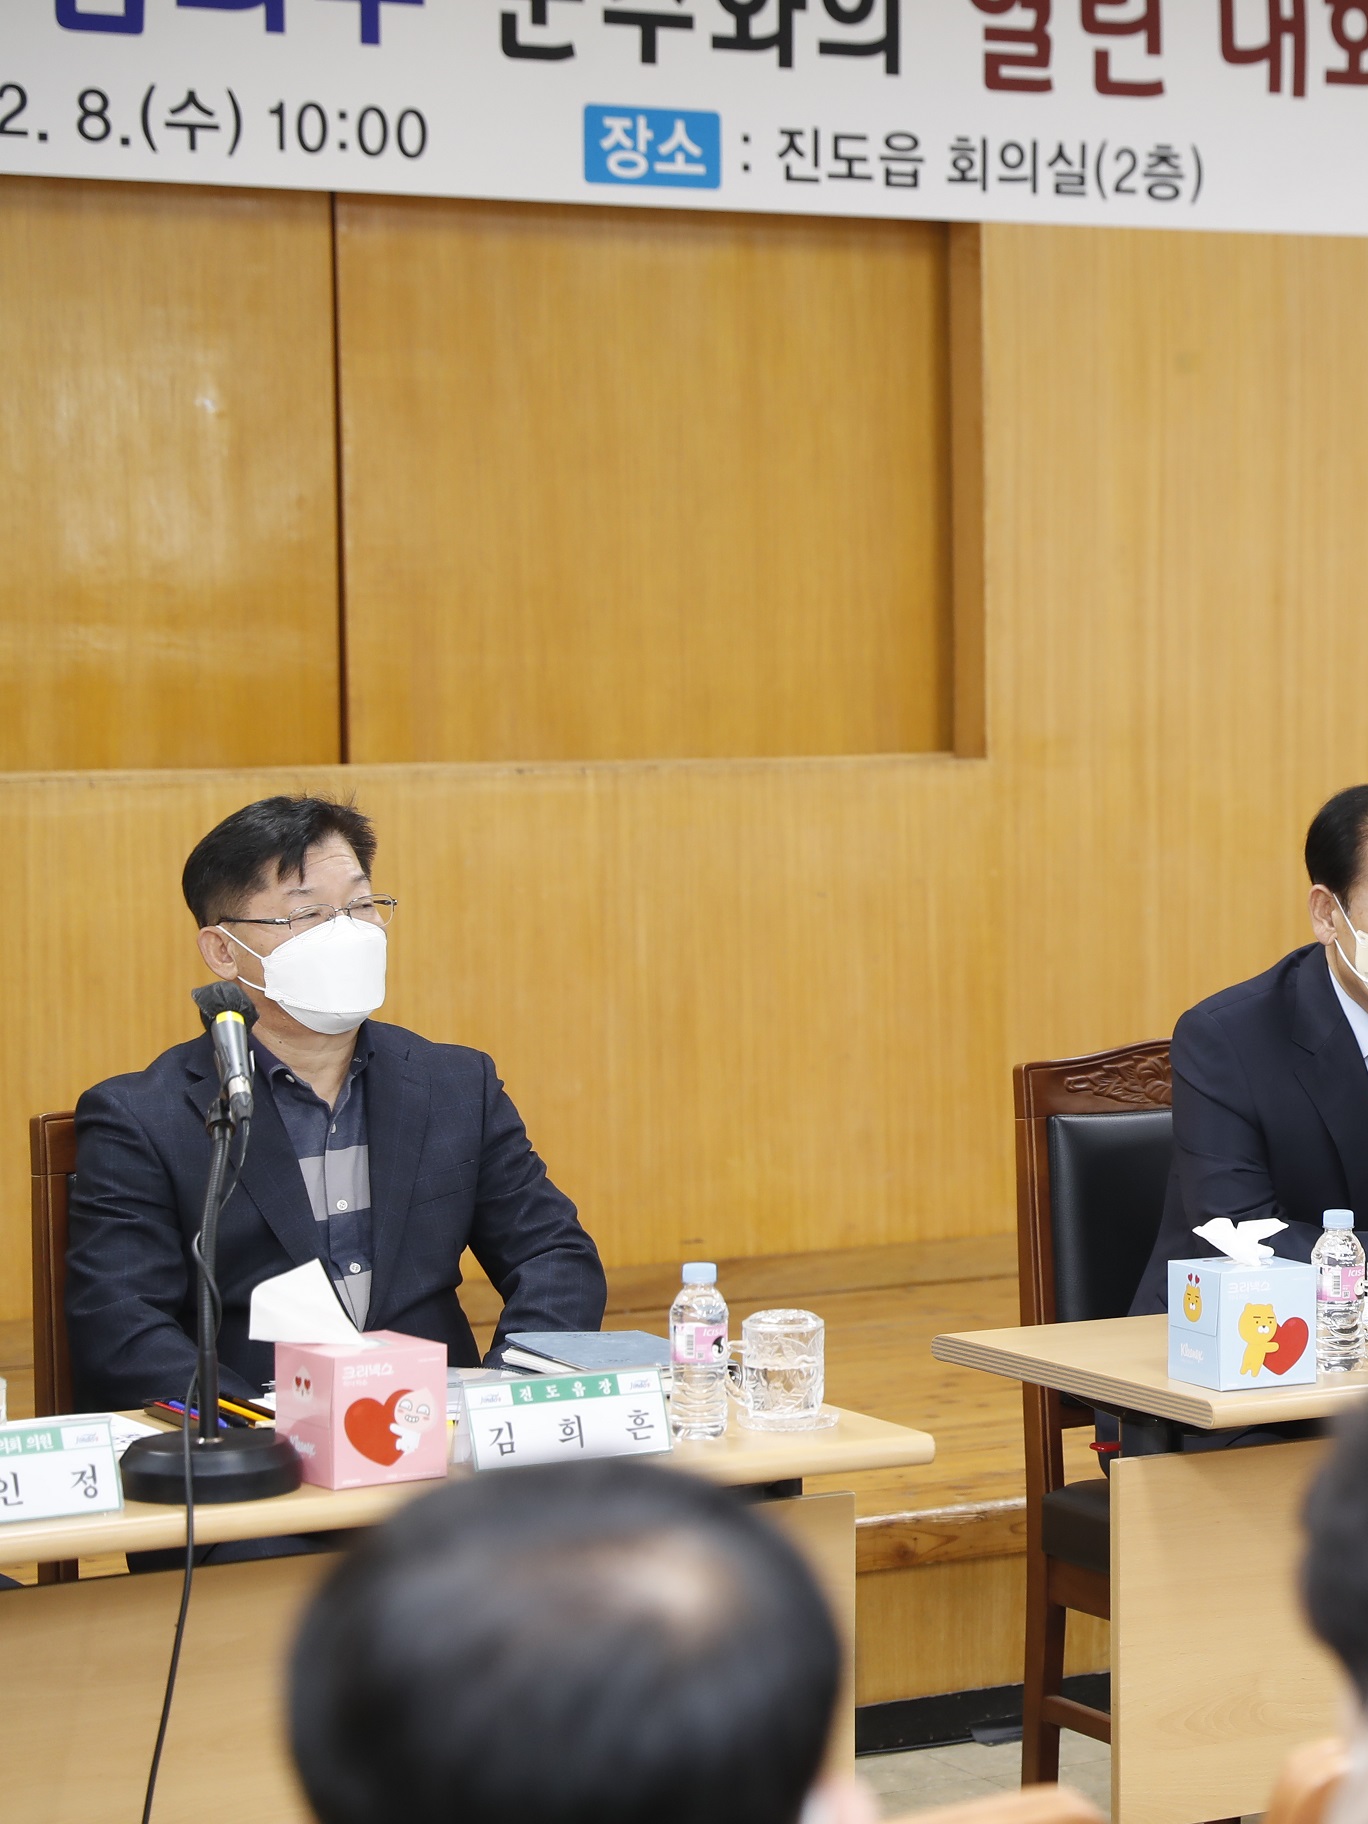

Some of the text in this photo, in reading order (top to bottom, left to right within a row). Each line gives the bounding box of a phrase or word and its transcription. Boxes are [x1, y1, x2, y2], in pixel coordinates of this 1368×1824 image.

[969, 0, 1166, 97] 열린
[77, 83, 243, 157] 8.(수)
[269, 99, 429, 160] 10:00
[599, 114, 709, 179] 장소
[777, 126, 926, 189] 진도읍
[946, 136, 1206, 204] 회의실(2층)
